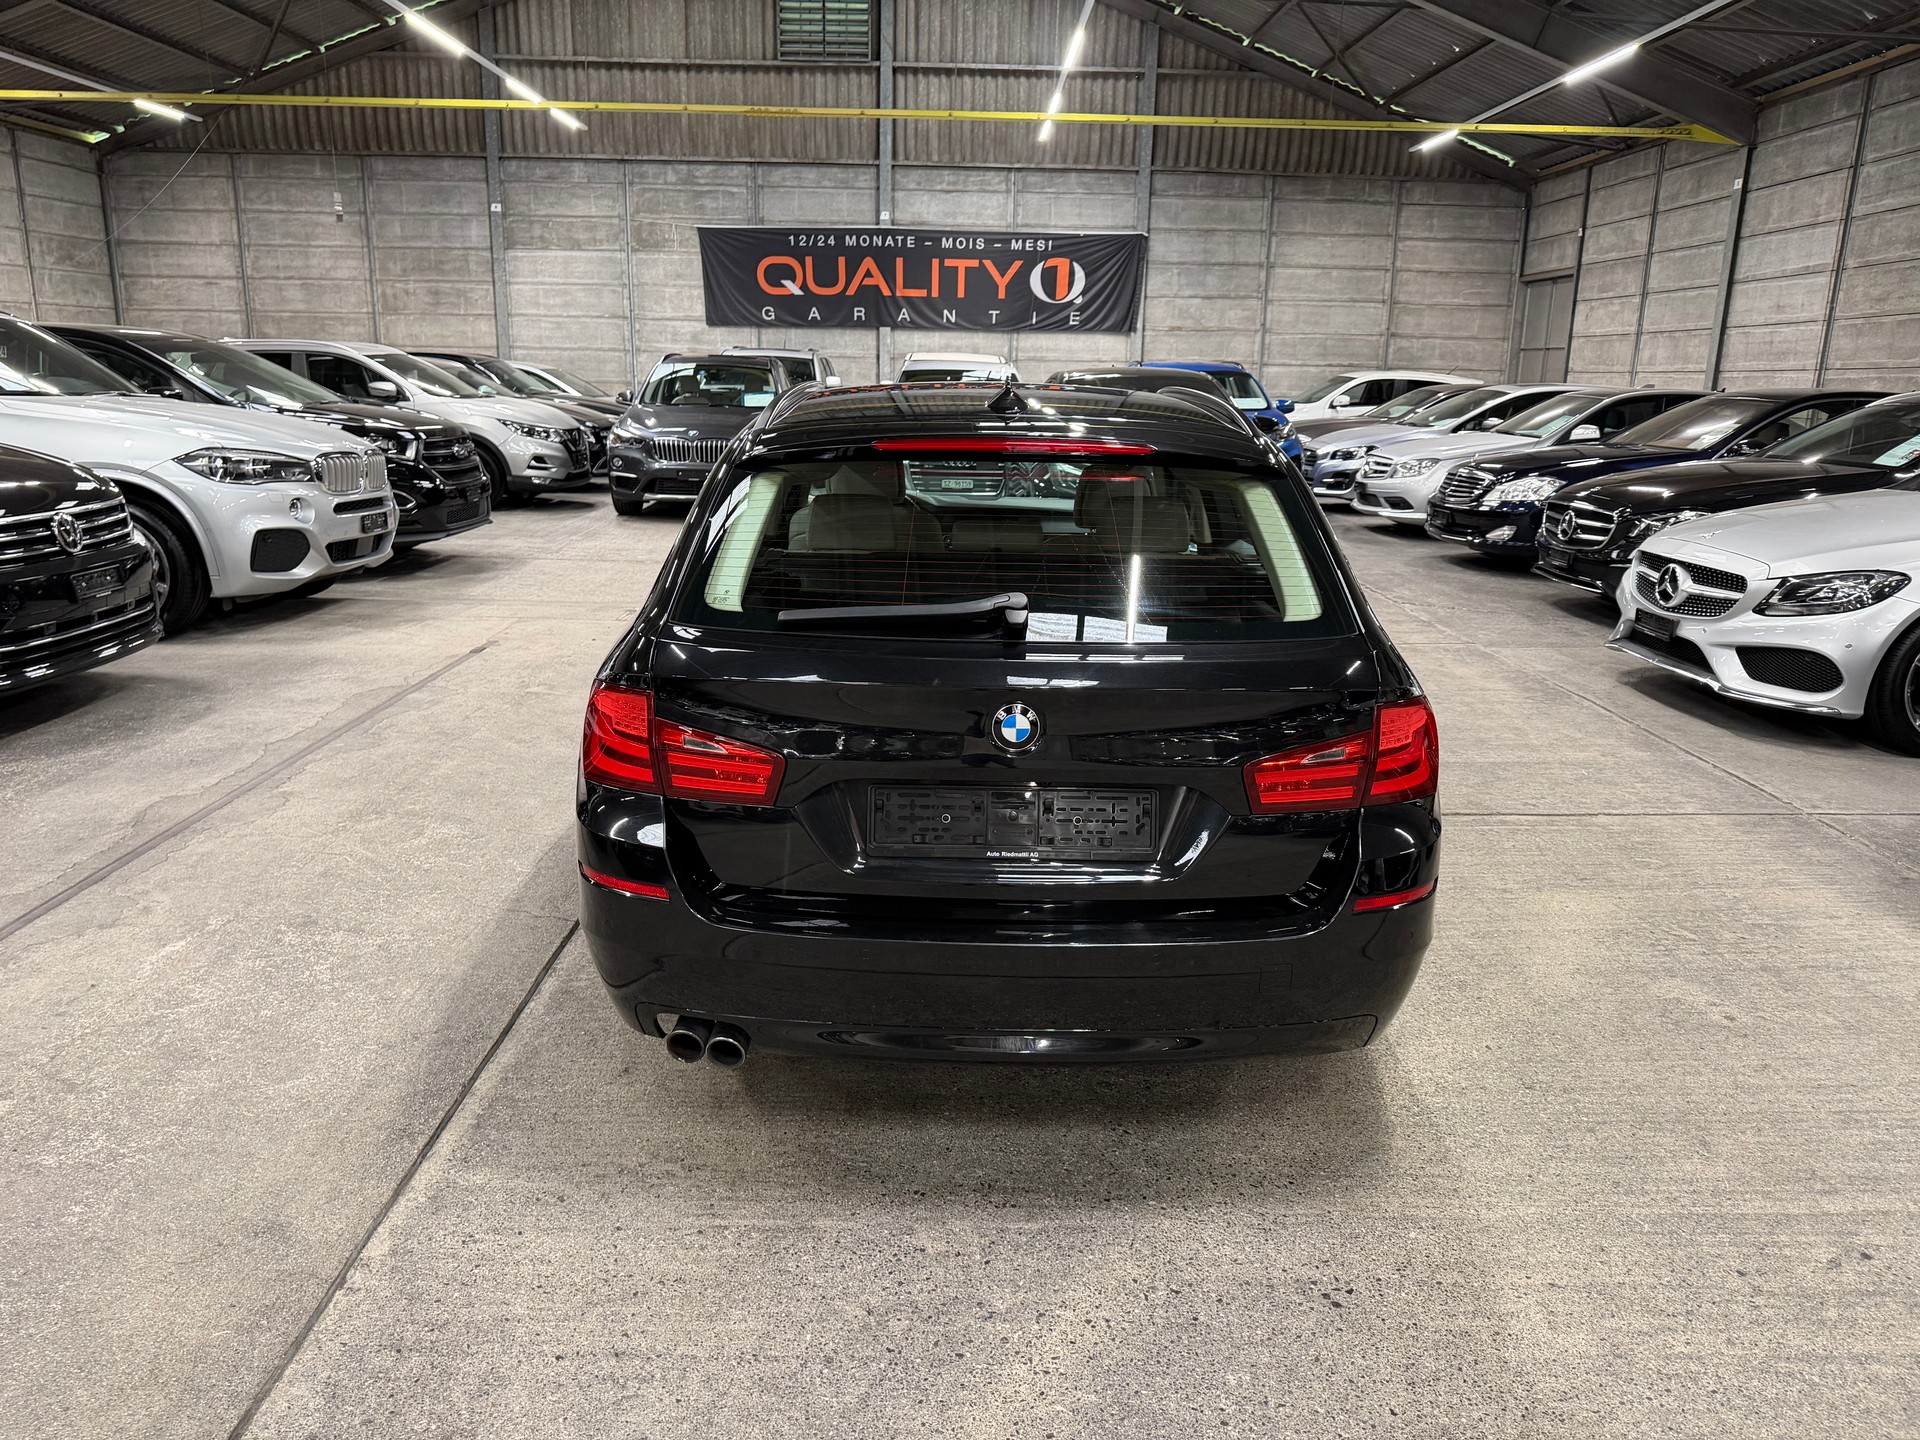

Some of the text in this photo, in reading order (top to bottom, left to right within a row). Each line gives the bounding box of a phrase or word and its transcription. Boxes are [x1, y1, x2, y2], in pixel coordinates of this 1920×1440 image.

[788, 234, 836, 247] 12/24
[845, 235, 916, 248] MONATE
[941, 237, 985, 250] MOIS
[1011, 239, 1053, 251] MESI
[756, 255, 1025, 300] QUALITY
[761, 306, 1081, 325] GARANTIE
[997, 703, 1036, 721] BMW
